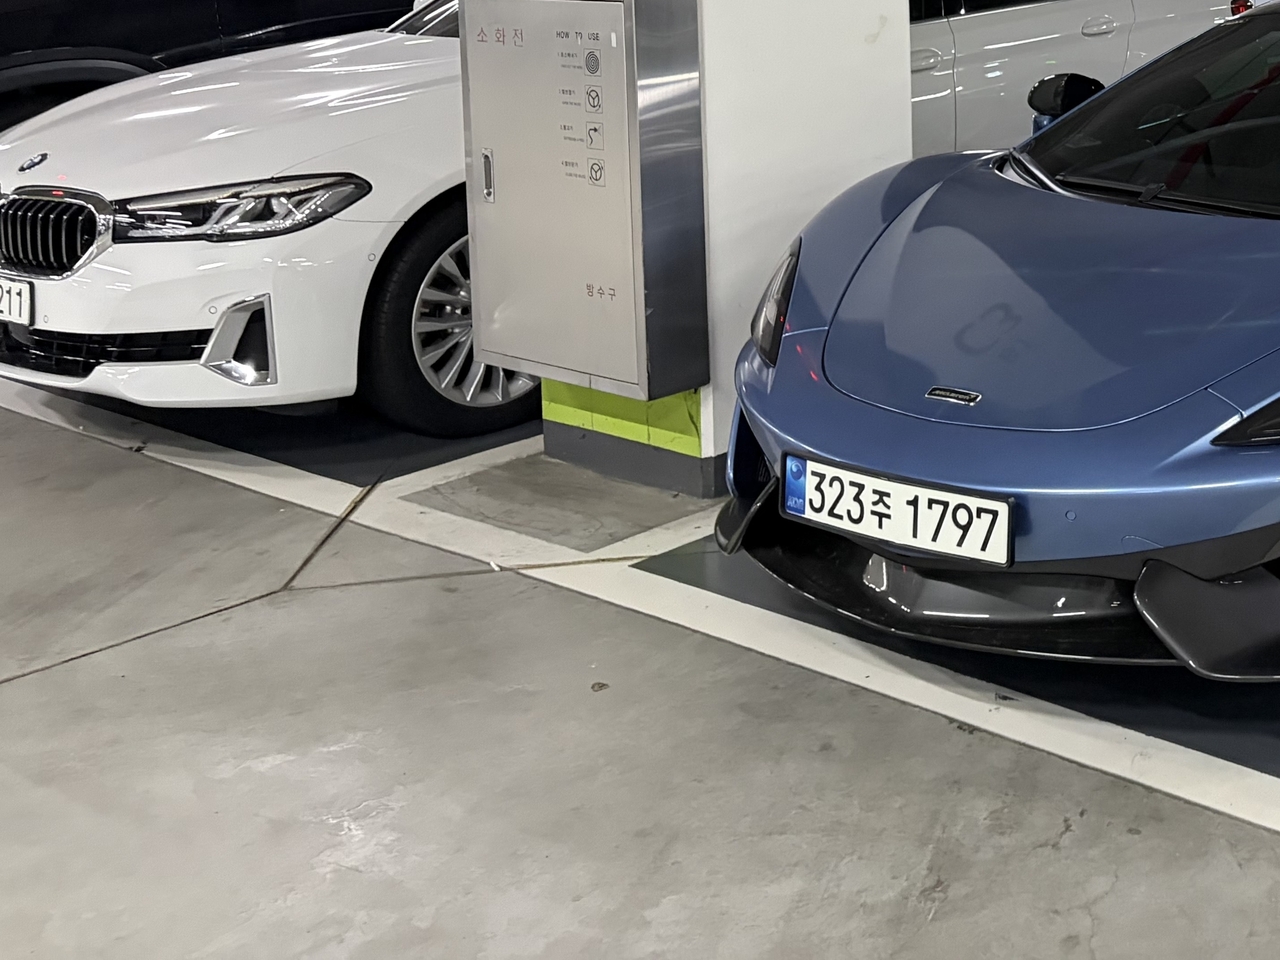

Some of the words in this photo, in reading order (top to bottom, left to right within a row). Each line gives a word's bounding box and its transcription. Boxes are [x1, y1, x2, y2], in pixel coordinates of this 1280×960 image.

[556, 30, 570, 39] HOW
[575, 31, 583, 40] TO
[588, 32, 600, 41] USE
[809, 470, 892, 530] 323주
[906, 494, 999, 552] 1797
